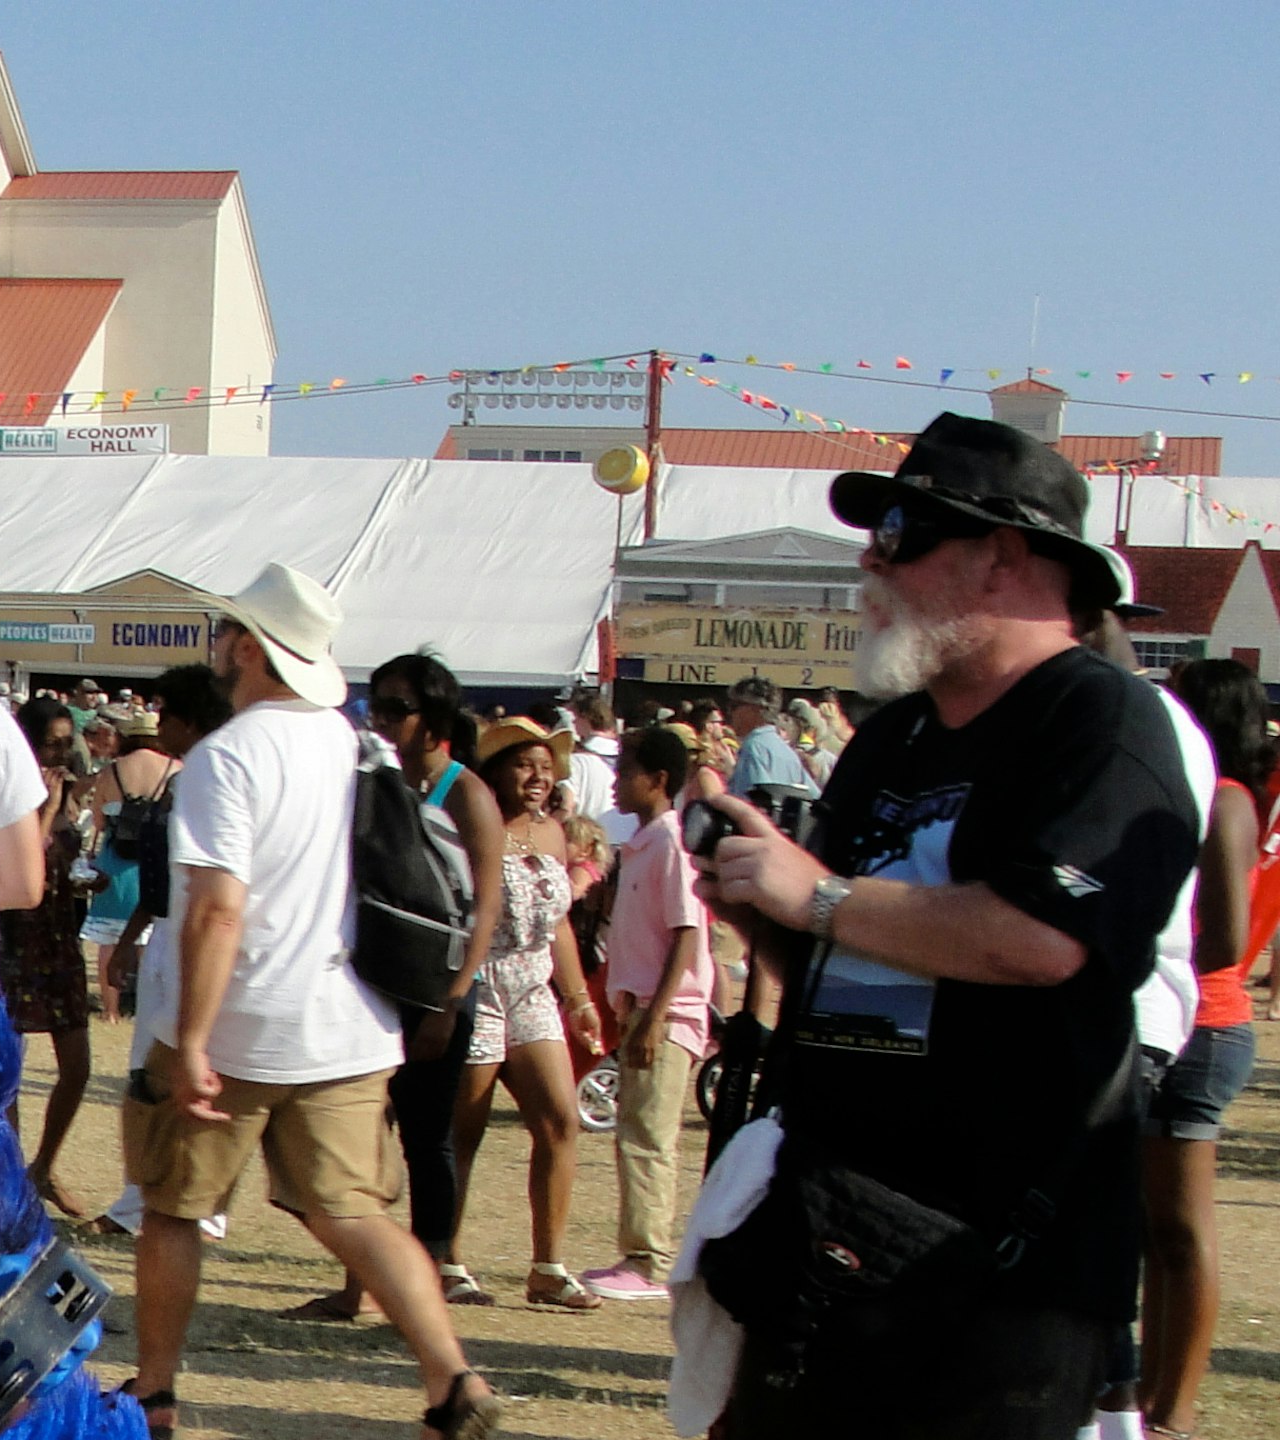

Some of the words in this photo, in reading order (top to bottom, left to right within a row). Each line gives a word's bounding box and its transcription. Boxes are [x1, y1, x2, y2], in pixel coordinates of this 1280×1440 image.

[5, 431, 54, 449] HEALTH
[66, 426, 157, 440] ECONOMY
[90, 440, 137, 453] HALL
[0, 625, 47, 640] PEOPLES
[112, 623, 201, 647] ECONOMY
[695, 618, 808, 650] LEMONADE
[667, 663, 717, 683] LINE
[801, 667, 814, 685] 2
